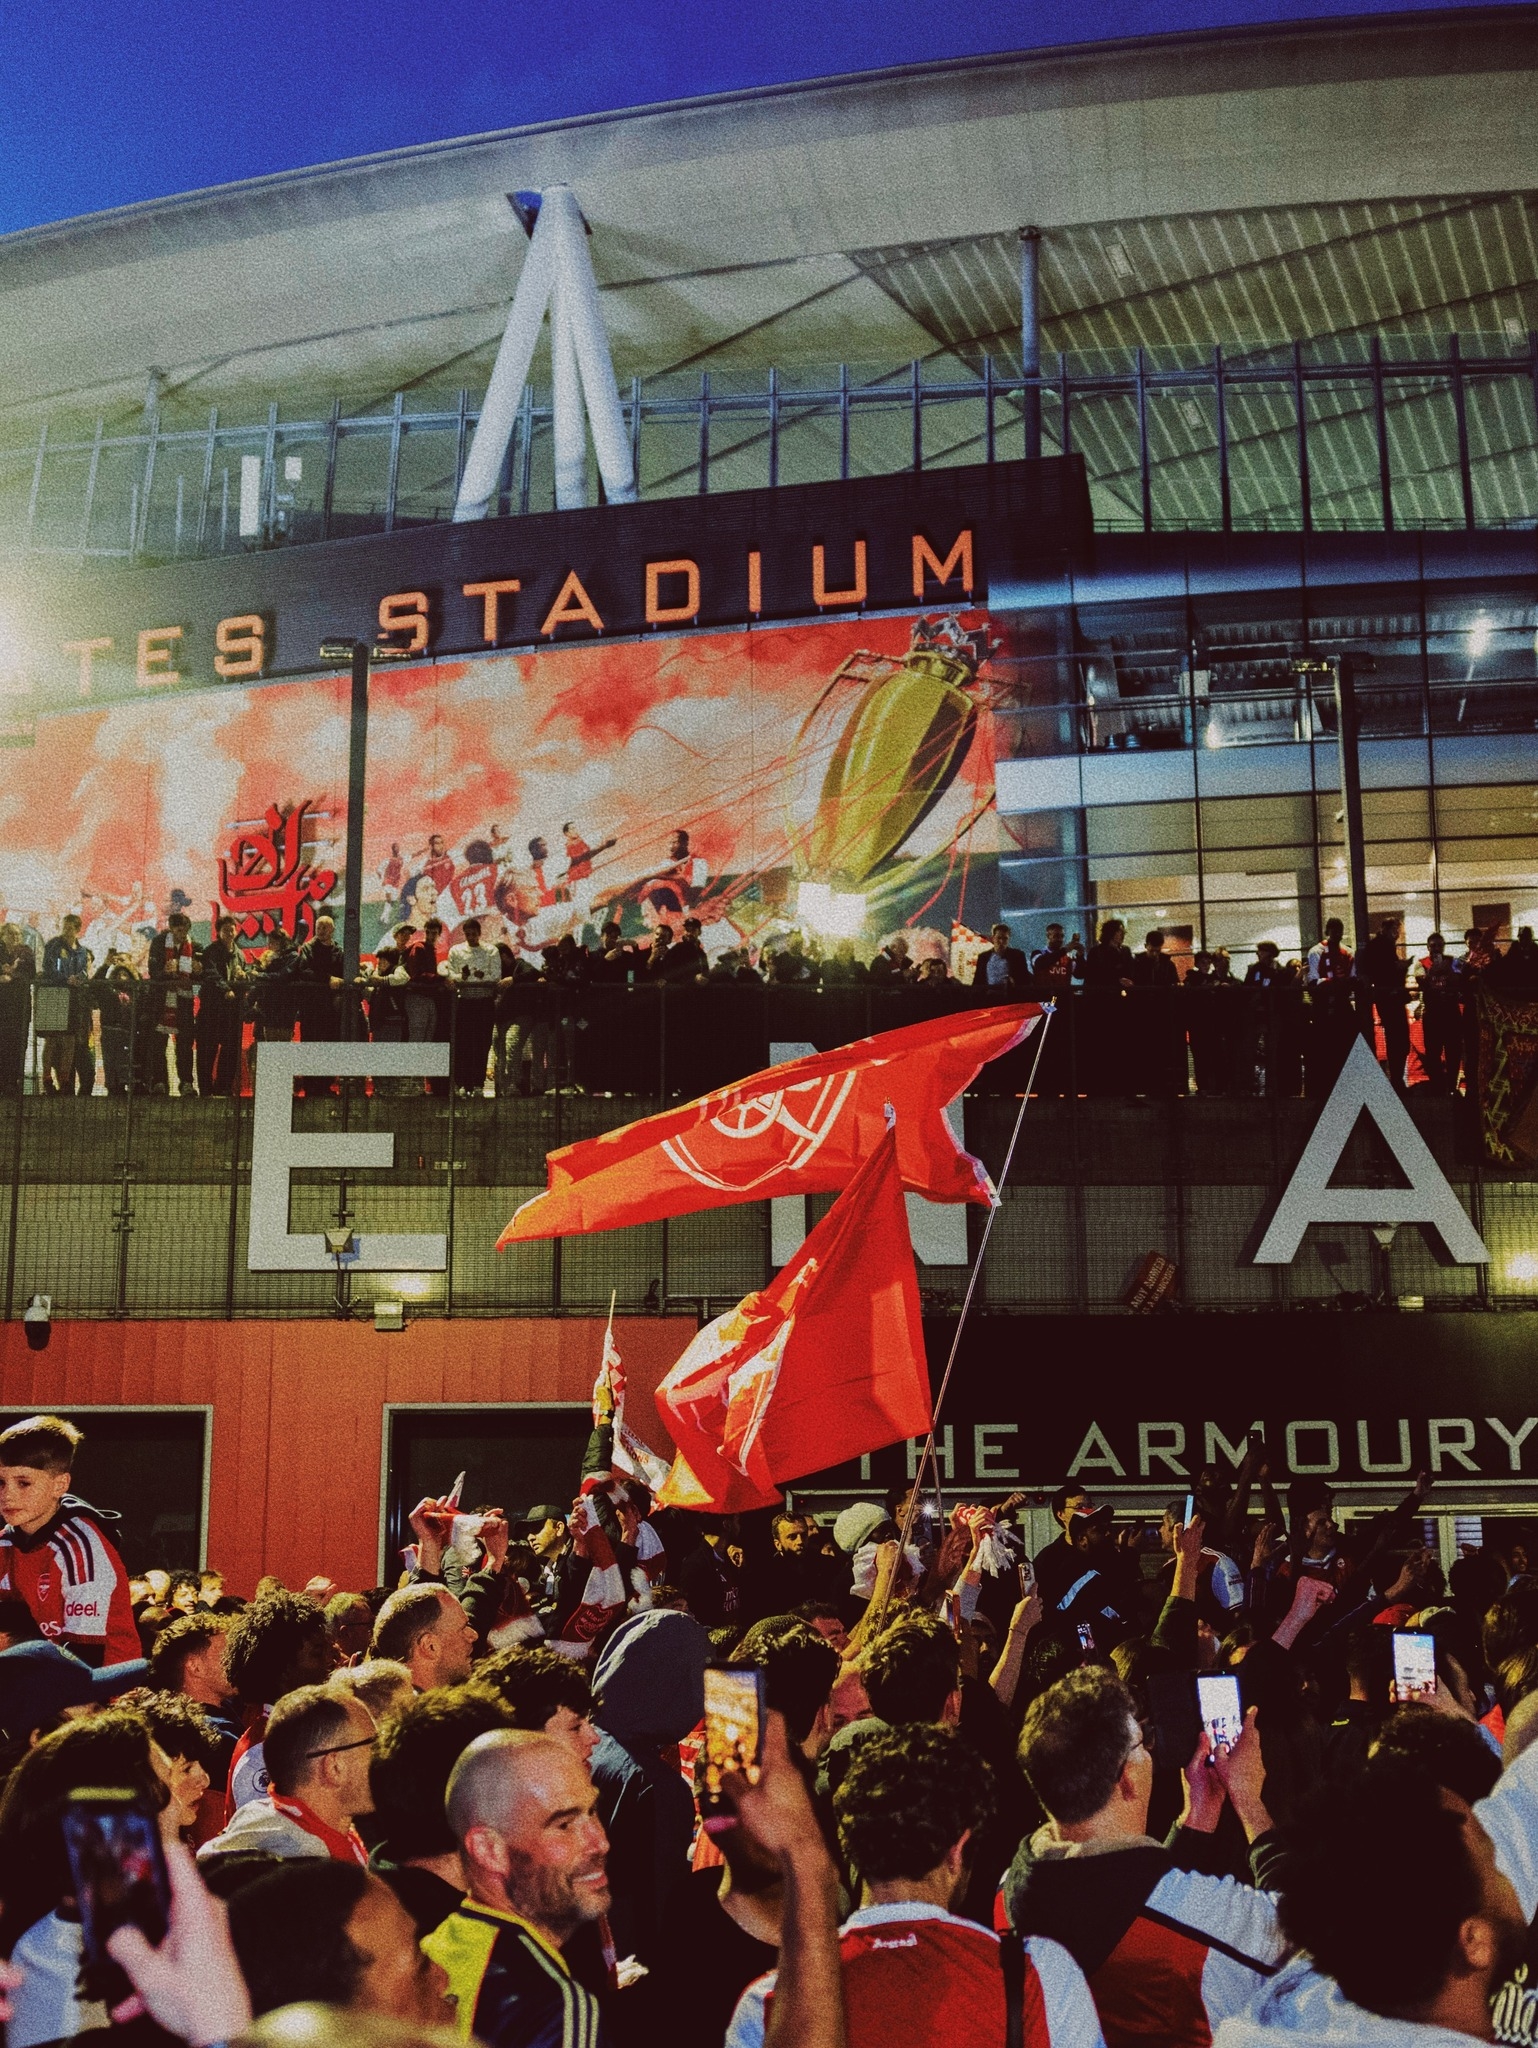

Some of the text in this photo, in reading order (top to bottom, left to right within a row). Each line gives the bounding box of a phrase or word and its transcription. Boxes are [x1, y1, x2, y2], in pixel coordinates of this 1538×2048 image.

[0, 529, 973, 697] TES STADIUM
[1049, 966, 1067, 975] JVC
[861, 1417, 1538, 1481] HE ARMOURY
